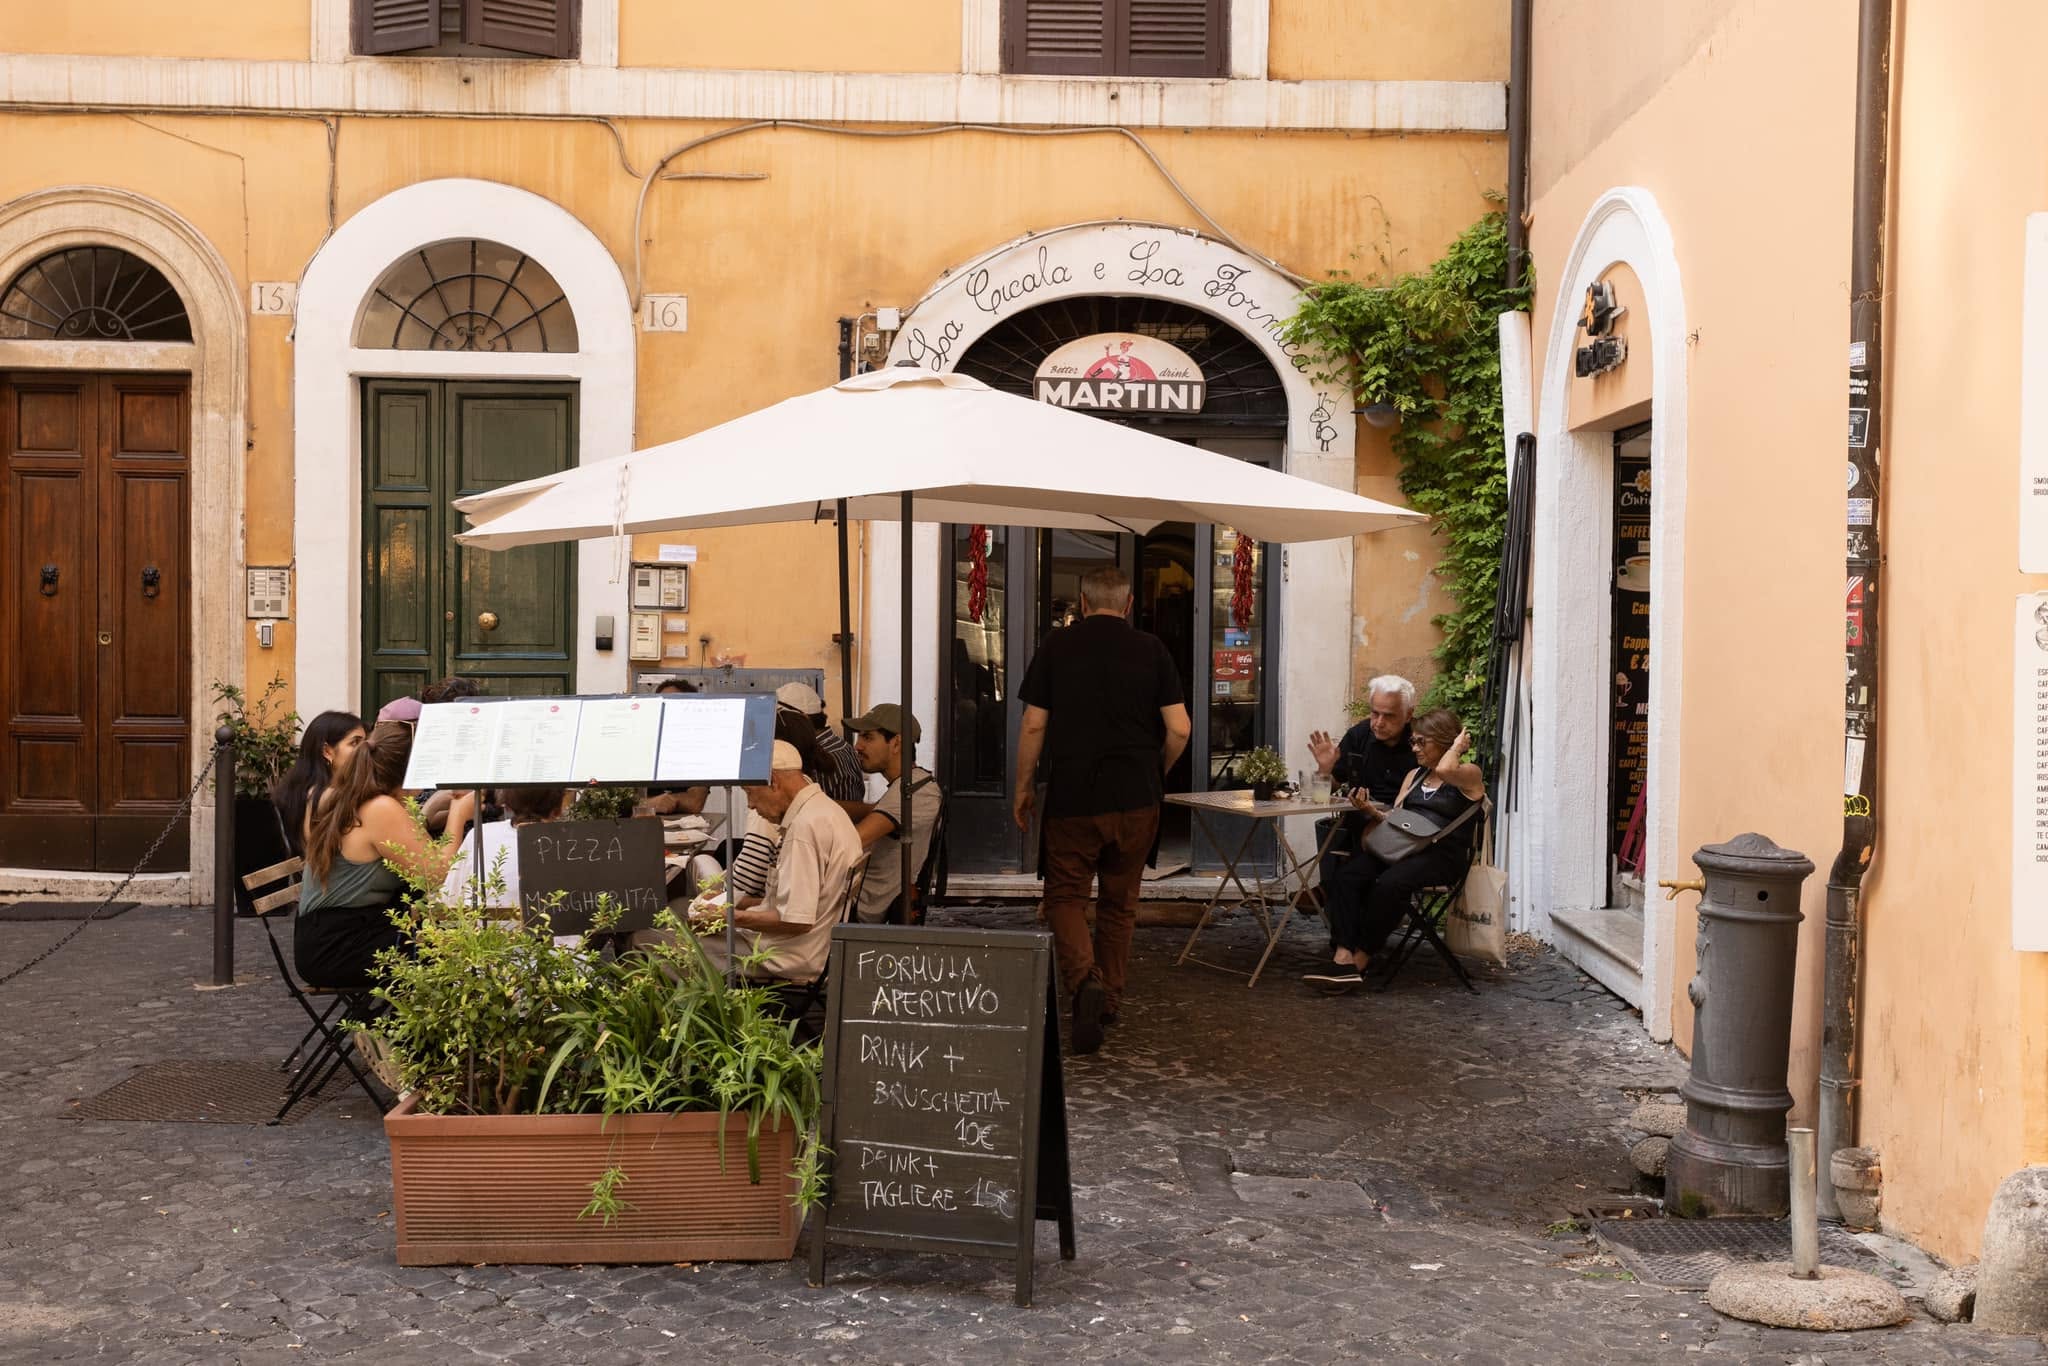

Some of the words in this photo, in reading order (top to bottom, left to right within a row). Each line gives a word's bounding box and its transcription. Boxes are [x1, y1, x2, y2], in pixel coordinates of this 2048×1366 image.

[965, 245, 1073, 314] Cicala
[1093, 262, 1106, 280] e
[1127, 240, 1185, 286] La
[256, 285, 285, 312] 15
[649, 301, 681, 327] 16
[1158, 367, 1191, 378] drink
[1038, 380, 1201, 410] MARTINI
[537, 835, 625, 864] PIZZA
[857, 949, 979, 984] FORMULA
[871, 983, 999, 1018] APERITIVO
[860, 1033, 930, 1073] DRINK
[942, 1044, 965, 1072] +
[872, 1080, 1011, 1115] BRUSCHETTA
[954, 1116, 999, 1151] 10€
[858, 1180, 958, 1212] TAGLIERE
